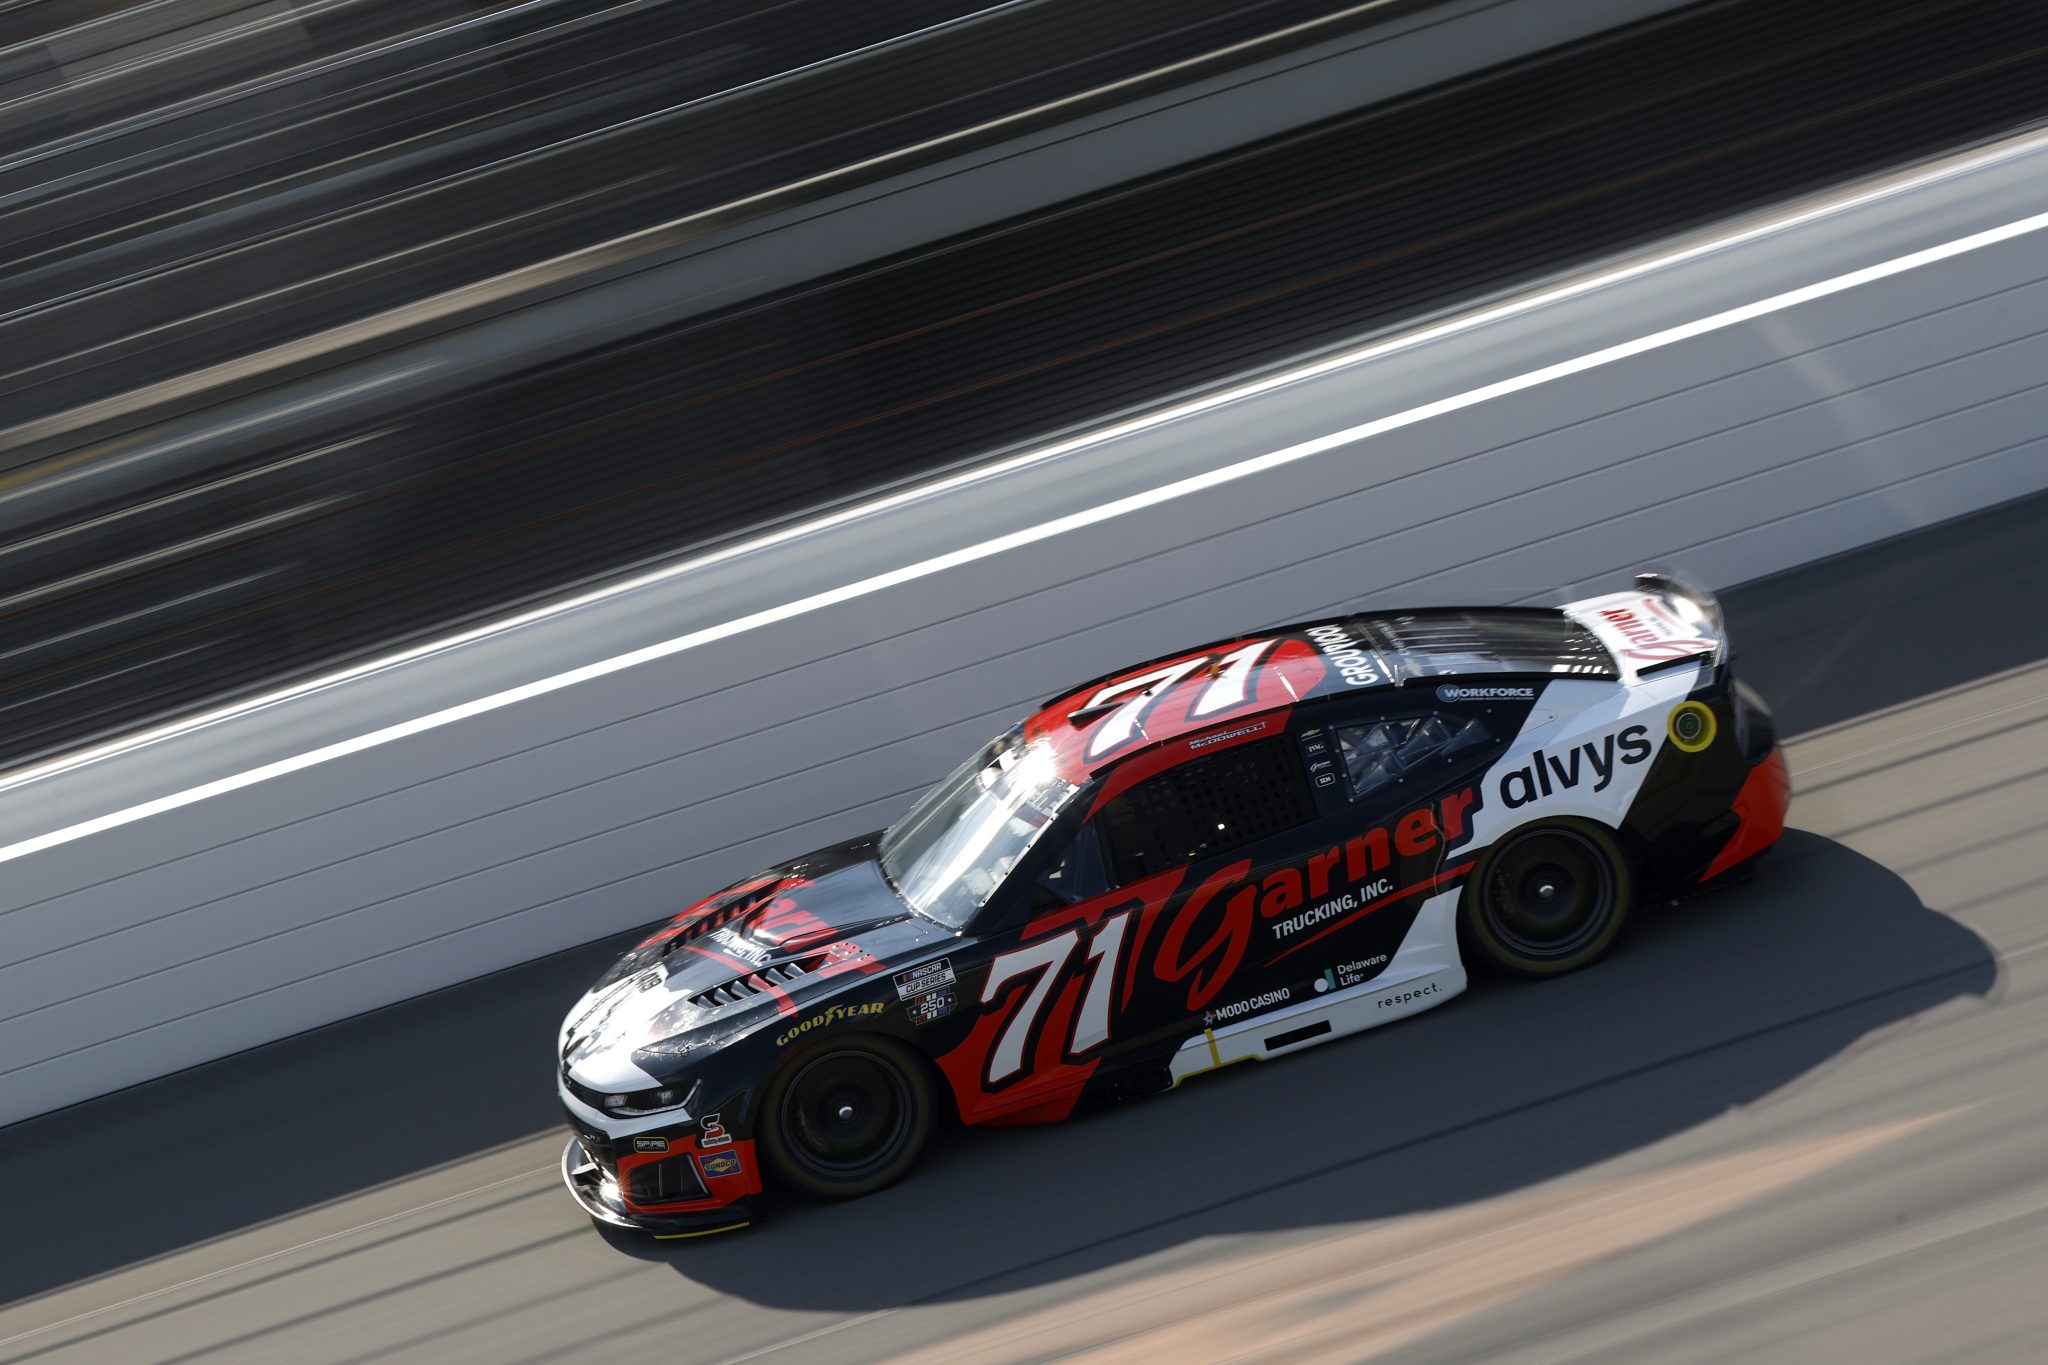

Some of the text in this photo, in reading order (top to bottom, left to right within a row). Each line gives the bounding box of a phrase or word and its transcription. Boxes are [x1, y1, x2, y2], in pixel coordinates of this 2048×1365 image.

[1082, 638, 1279, 758] 71
[1443, 686, 1535, 698] WORKFORCE
[1500, 724, 1653, 809] alvys
[1153, 787, 1474, 1012] Garner
[1272, 877, 1394, 940] TRUCKING, INC.
[912, 963, 942, 979] NASCAR
[1336, 953, 1388, 976] Delaware
[906, 973, 946, 993] CUP SERIES
[980, 911, 1130, 1084] 71
[1376, 982, 1444, 1010] respect.
[920, 996, 945, 1014] 250
[1214, 986, 1291, 1021] MODO CASINO
[776, 1001, 886, 1047] GOODYEAR
[705, 1159, 736, 1172] SUNOCO
